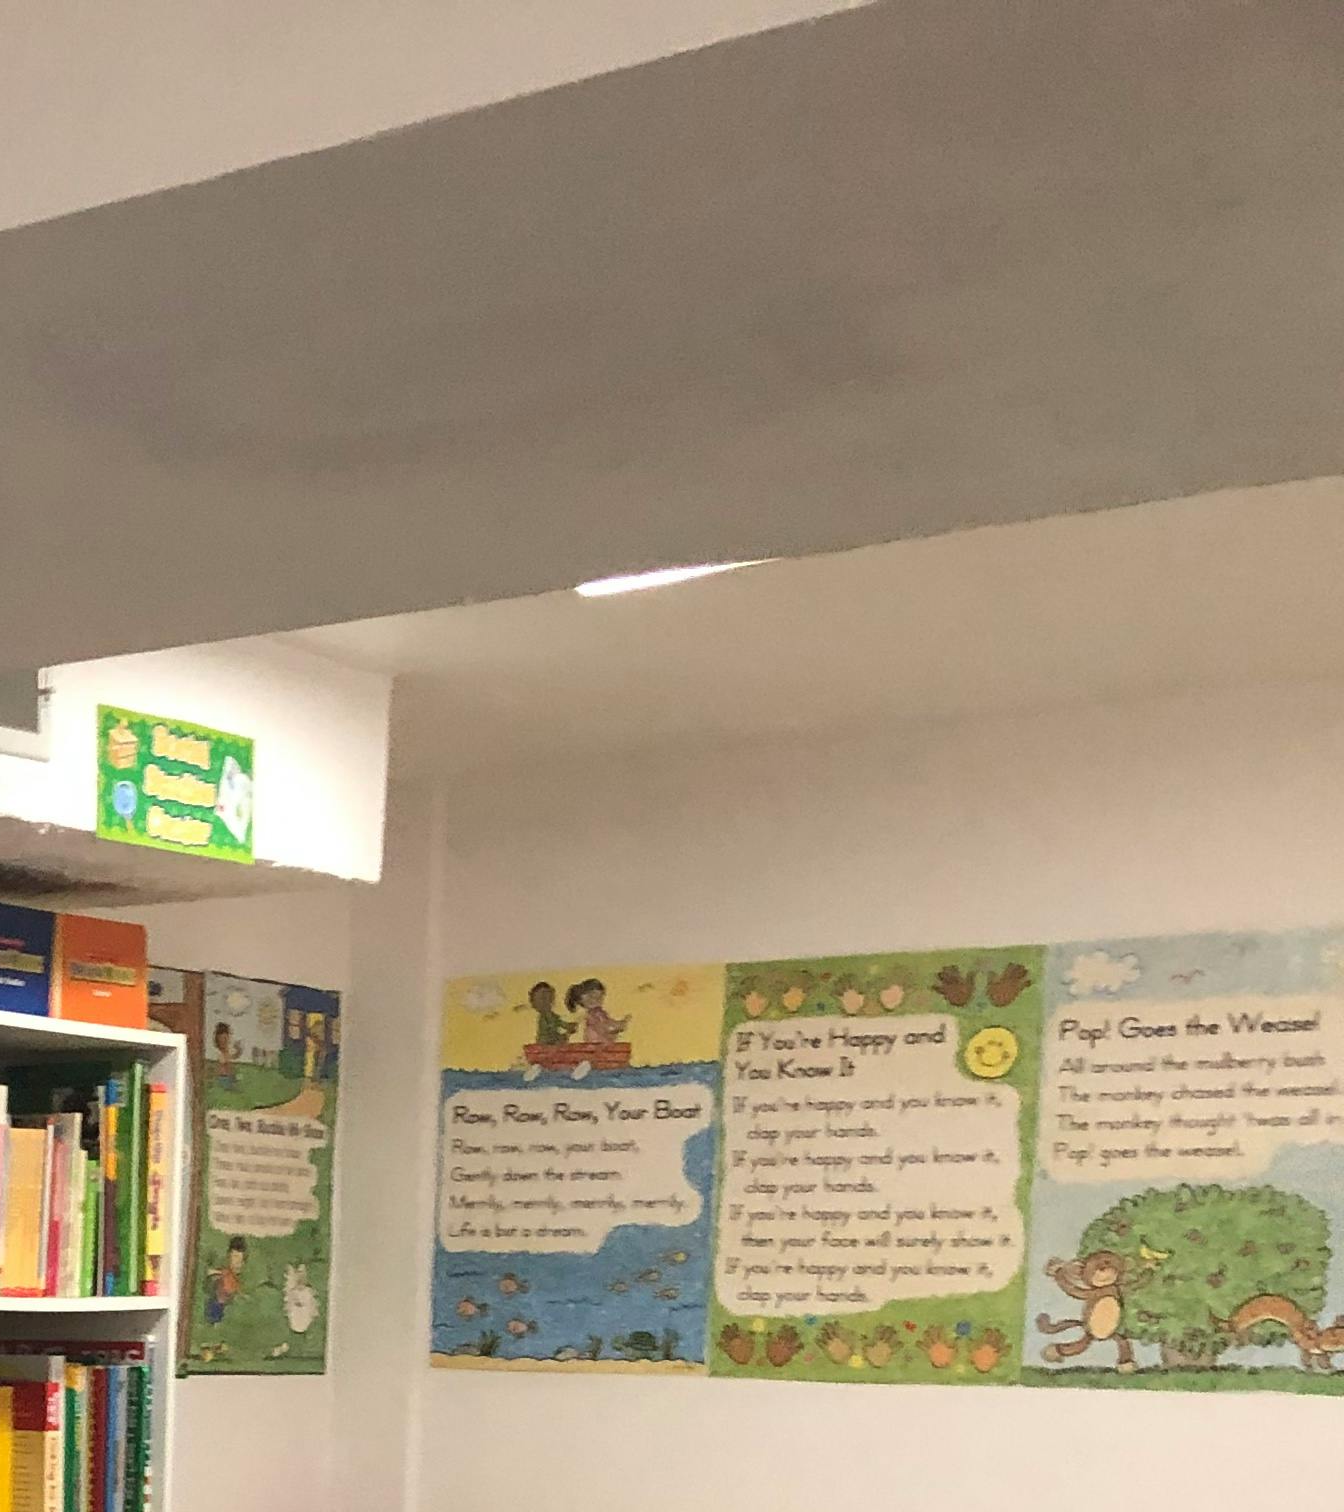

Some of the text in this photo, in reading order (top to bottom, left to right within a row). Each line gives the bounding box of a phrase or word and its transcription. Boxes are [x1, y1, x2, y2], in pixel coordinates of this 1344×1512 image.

[736, 1022, 947, 1056] If You're Happy and
[1059, 1010, 1322, 1049] Pop! Goes the Weasel
[735, 1056, 856, 1080] You Know It
[1059, 1056, 1085, 1074] All
[1090, 1056, 1155, 1073] around
[1160, 1053, 1188, 1071] the
[1194, 1052, 1276, 1076] mulberry
[732, 1095, 747, 1114] If
[805, 1095, 855, 1117] happy
[863, 1092, 895, 1110] and
[900, 1096, 928, 1114] you
[934, 1091, 978, 1107] know
[1058, 1086, 1090, 1102] The
[1097, 1085, 1162, 1107] monkey
[1171, 1082, 1236, 1099] chased
[1241, 1081, 1270, 1097] the
[452, 1099, 702, 1128] Row, Row, Row, Your Boat
[1056, 1114, 1089, 1131] The
[1095, 1113, 1161, 1136] monkey
[1169, 1111, 1236, 1137] thought
[1296, 1108, 1319, 1126] all
[747, 1122, 780, 1146] clap
[784, 1128, 821, 1145] your
[732, 1150, 747, 1167] If
[805, 1151, 852, 1173] happy
[858, 1146, 893, 1165] and
[899, 1152, 926, 1171] you
[933, 1145, 977, 1163] know
[1053, 1142, 1095, 1167] Pop!
[1099, 1148, 1138, 1168] goes
[1143, 1141, 1172, 1158] the
[543, 1166, 565, 1182] the
[744, 1176, 779, 1200] clap
[782, 1182, 818, 1201] your
[729, 1204, 745, 1221] If
[802, 1204, 851, 1227] happy
[858, 1202, 891, 1220] and
[896, 1208, 925, 1227] you
[929, 1202, 975, 1219] know
[780, 1236, 816, 1254] your
[821, 1230, 860, 1248] face
[864, 1230, 891, 1247] will
[896, 1231, 944, 1255] surely
[950, 1231, 993, 1247] show
[724, 1257, 742, 1275] If
[798, 1256, 849, 1280] happy
[852, 1257, 887, 1275] and
[891, 1264, 921, 1283] you
[926, 1258, 970, 1275] know
[737, 1285, 771, 1308] clap
[775, 1290, 811, 1308] your
